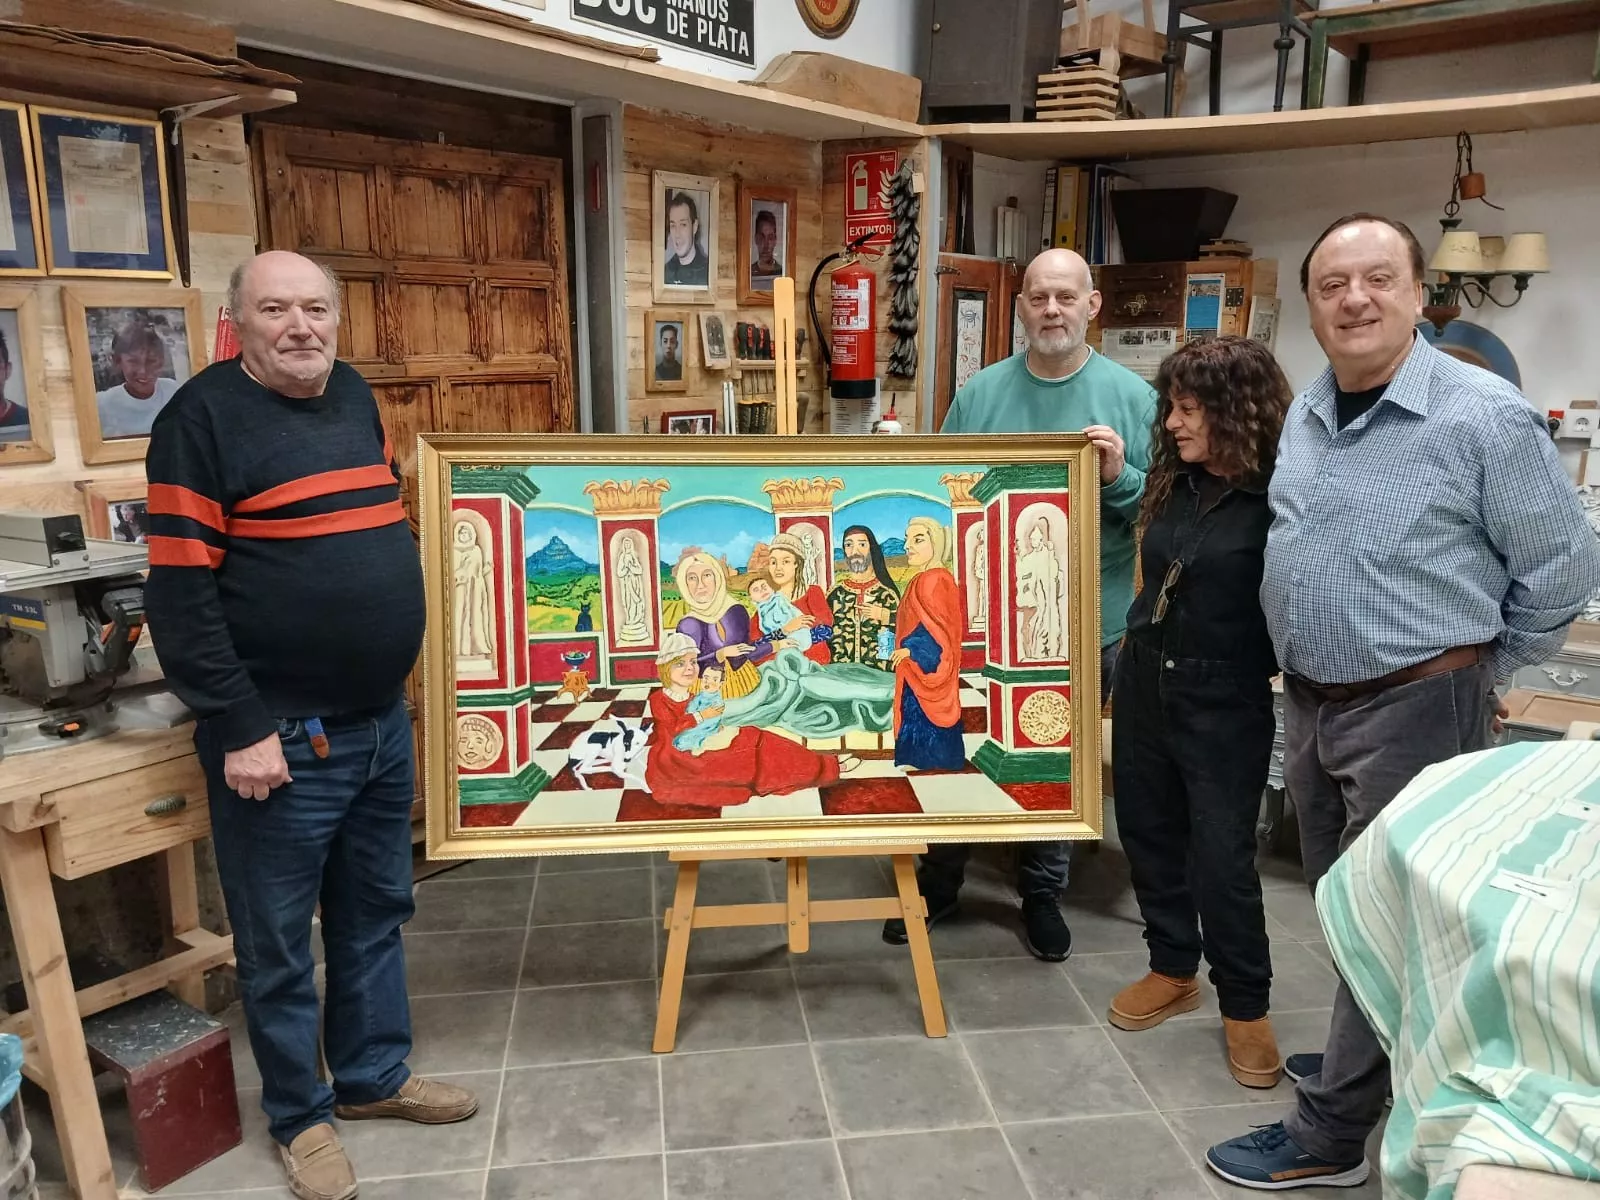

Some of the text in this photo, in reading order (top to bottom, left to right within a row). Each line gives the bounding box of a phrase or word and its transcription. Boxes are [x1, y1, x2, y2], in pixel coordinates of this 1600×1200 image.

[667, 0, 729, 23] ANOS
[666, 7, 689, 39] DE
[697, 17, 750, 57] PLATA
[849, 223, 892, 237] EXTINTOR
